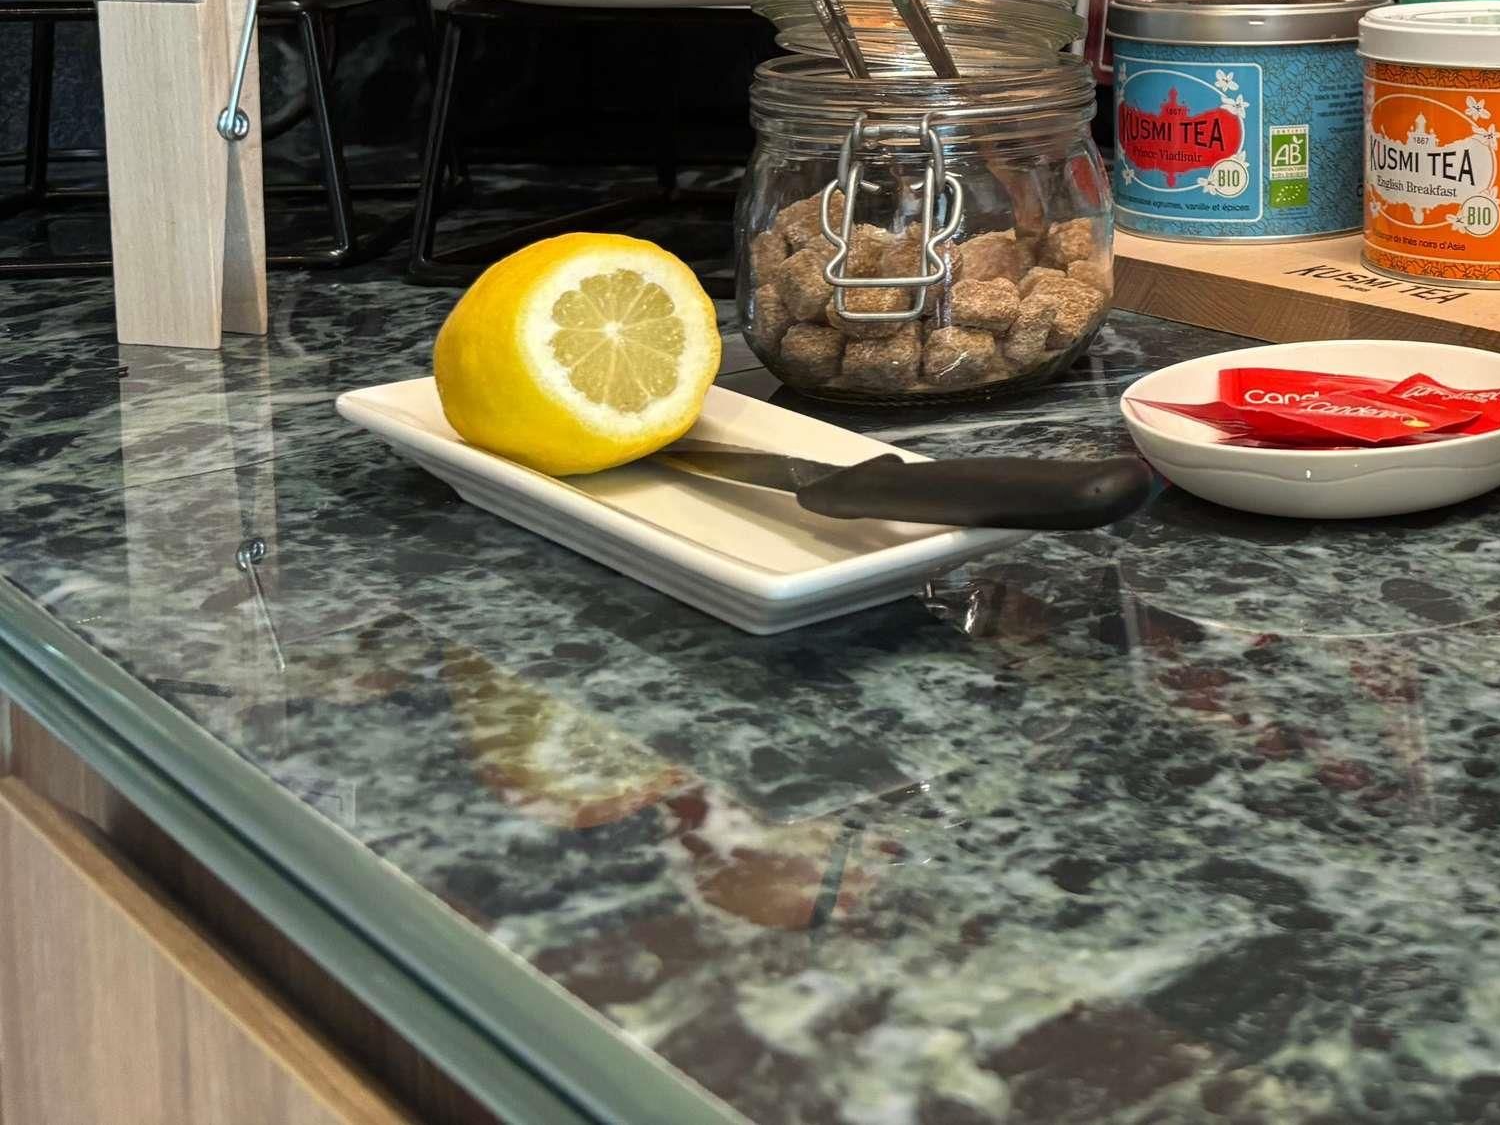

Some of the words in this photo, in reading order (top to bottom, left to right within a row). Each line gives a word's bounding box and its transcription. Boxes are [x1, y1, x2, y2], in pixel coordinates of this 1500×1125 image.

[1122, 106, 1172, 142] KUSMI
[1180, 118, 1224, 151] TEA
[1159, 149, 1202, 163] Vladimir
[1274, 143, 1302, 165] AB
[1370, 134, 1419, 173] KUSMI
[1427, 149, 1475, 186] TEA
[1218, 169, 1240, 187] BIO
[1377, 175, 1404, 191] English
[1407, 180, 1458, 198] Breakfast
[1467, 206, 1491, 226] BIO
[1284, 264, 1398, 289] KUSMI
[1400, 284, 1470, 304] TEA
